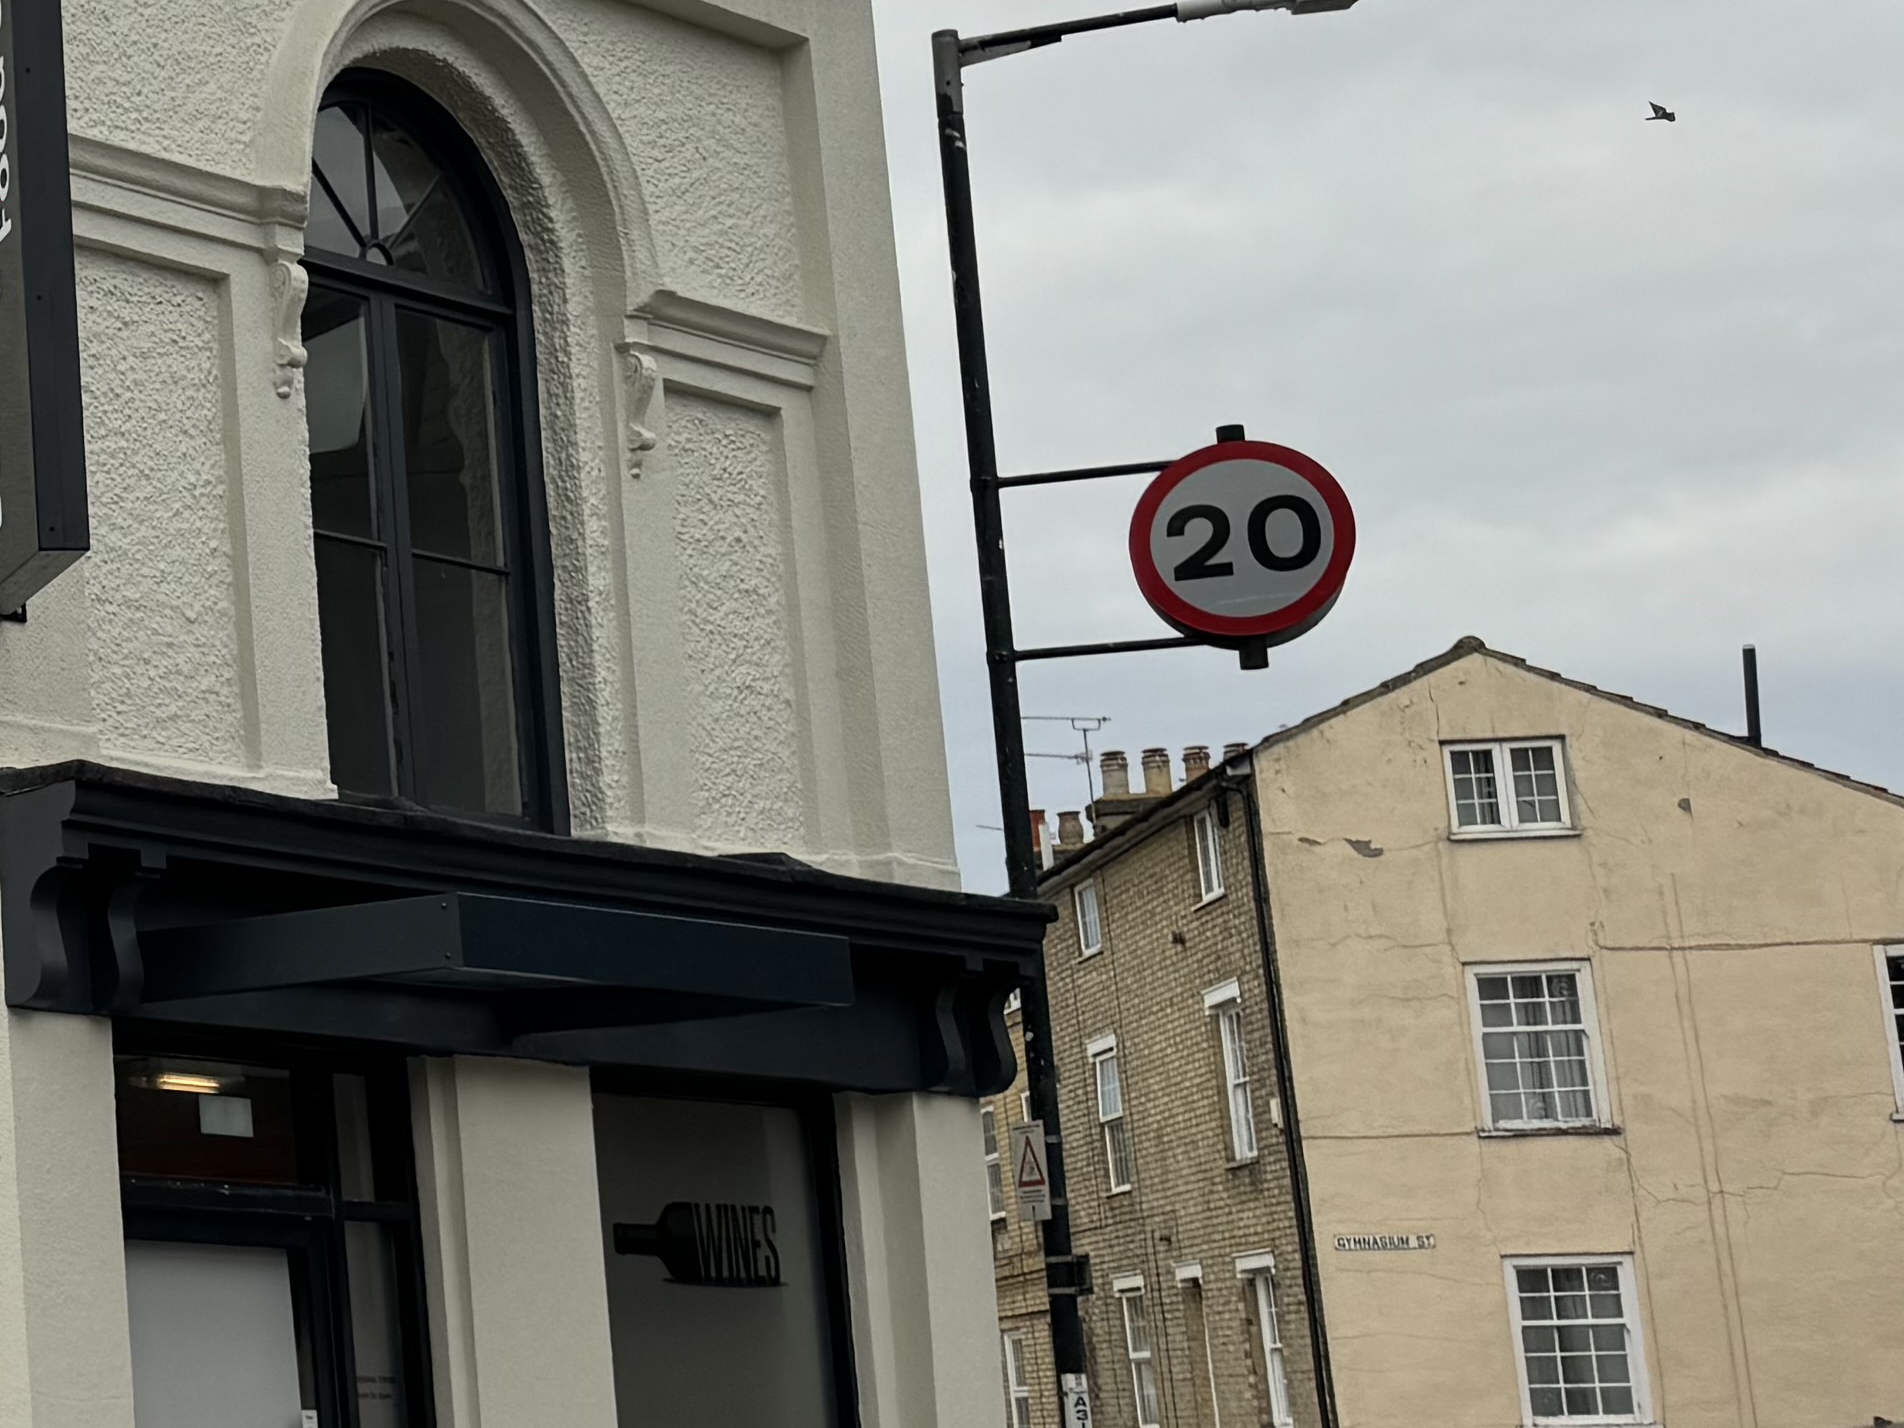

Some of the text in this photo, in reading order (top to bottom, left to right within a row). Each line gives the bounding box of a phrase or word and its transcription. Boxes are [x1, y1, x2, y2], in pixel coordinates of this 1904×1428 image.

[1165, 493, 1323, 581] 20
[692, 1202, 781, 1288] WINES
[1337, 1235, 1410, 1249] GYMNASIUM
